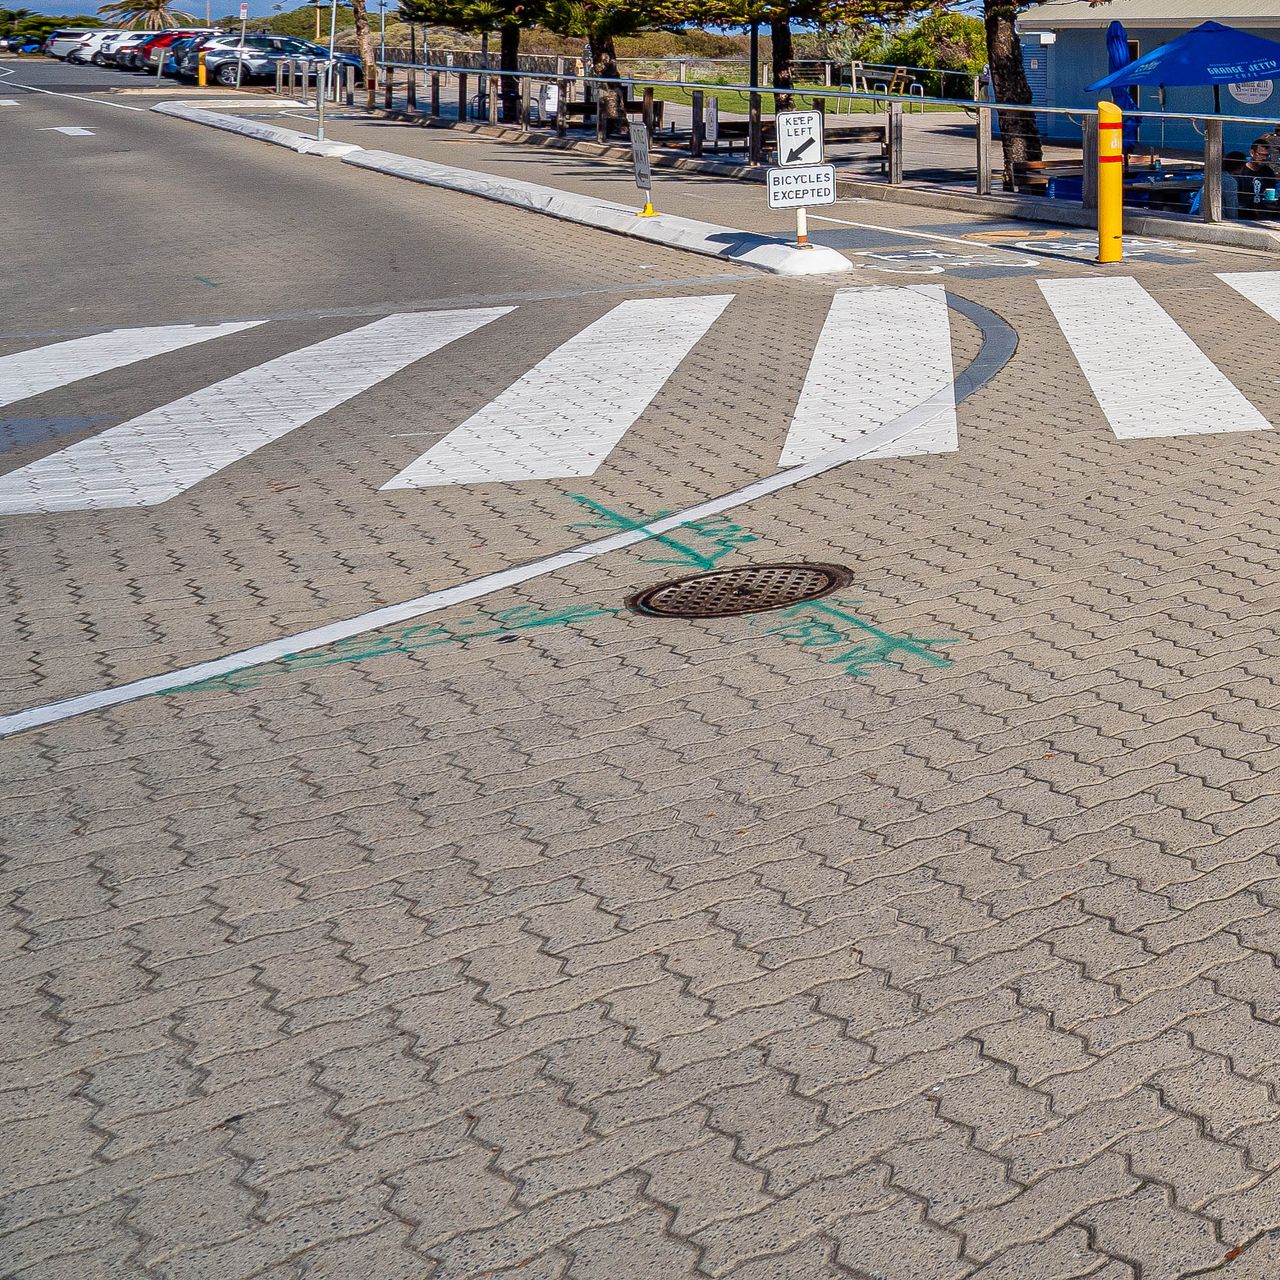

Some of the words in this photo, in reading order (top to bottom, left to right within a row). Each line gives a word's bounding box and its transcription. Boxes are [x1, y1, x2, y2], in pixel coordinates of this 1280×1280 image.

[1207, 65, 1245, 75] GRANGE
[1248, 60, 1277, 72] JETTY
[785, 116, 814, 126] KEEP
[787, 127, 813, 137] LEFT
[773, 173, 831, 186] BICYCLES
[773, 187, 831, 201] EXCEPTED
